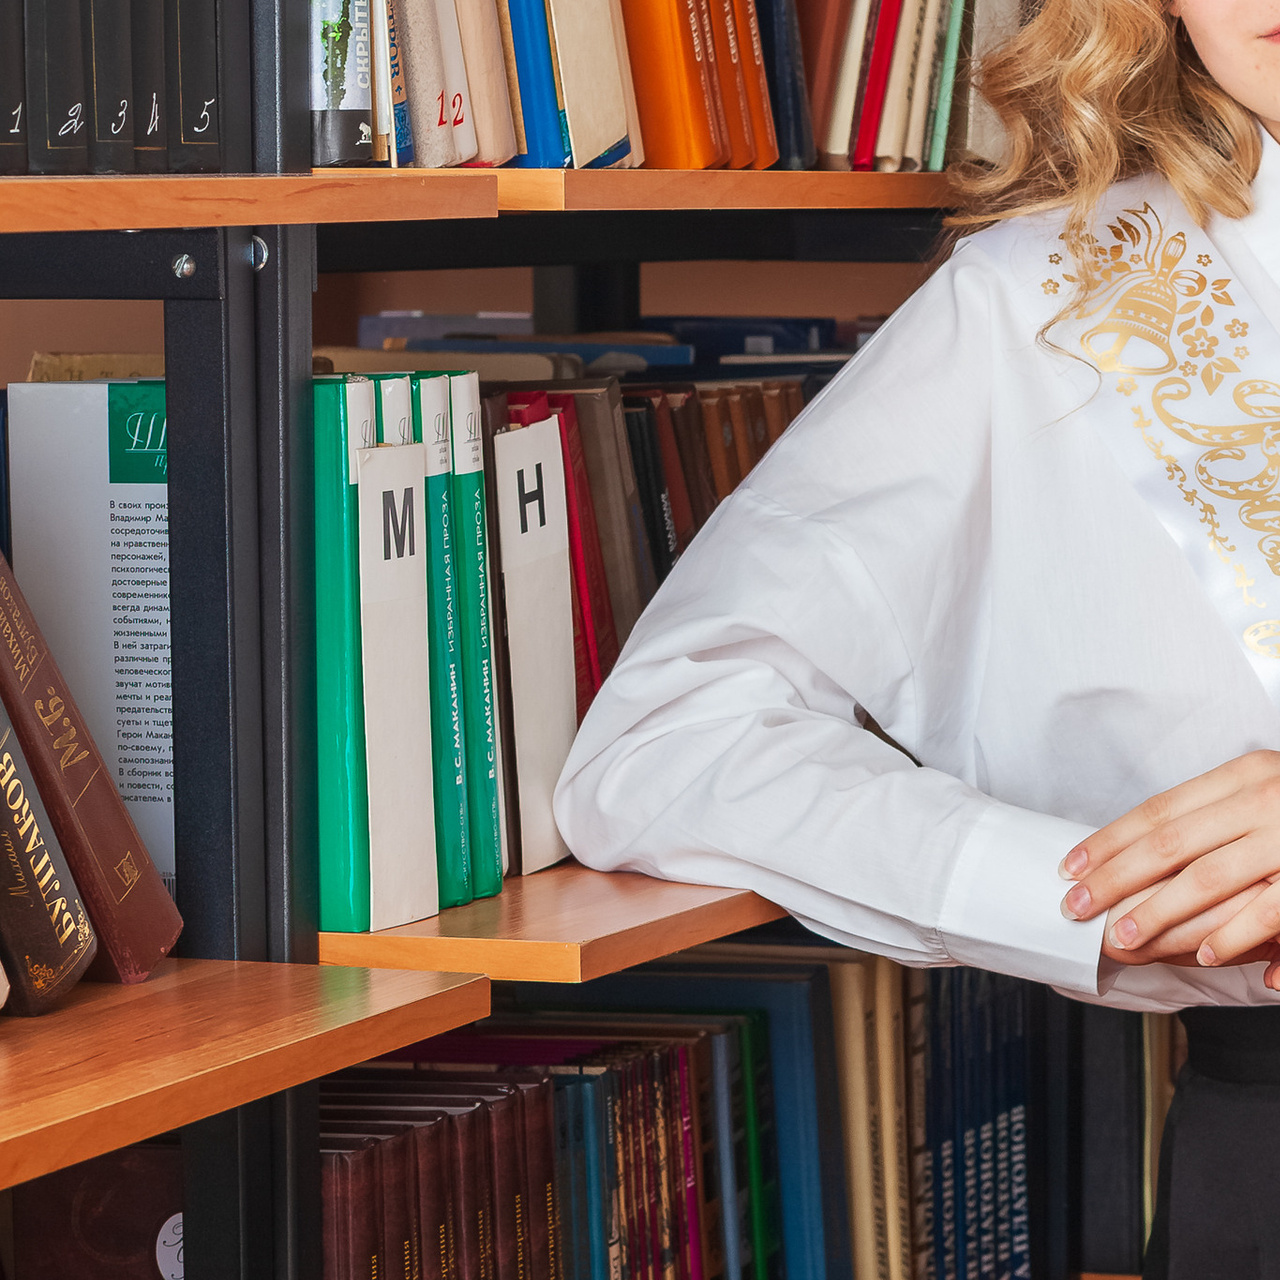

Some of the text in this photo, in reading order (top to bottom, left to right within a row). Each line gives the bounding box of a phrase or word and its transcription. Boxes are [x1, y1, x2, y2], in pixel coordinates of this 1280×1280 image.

[689, 11, 703, 63] СЕРГЕЙ
[146, 92, 160, 136] 4
[437, 89, 448, 128] 1
[451, 92, 465, 128] 2
[9, 102, 23, 134] 1
[58, 102, 85, 137] 2
[111, 99, 128, 135] 3
[193, 98, 216, 133] 5
[517, 462, 547, 534] Н
[109, 500, 142, 510] В своих
[110, 513, 152, 525] Владимир
[382, 487, 416, 561] М
[110, 552, 166, 563] персонажей,
[111, 579, 168, 588] достоверные
[112, 605, 142, 613] всегда
[112, 615, 163, 626] событиями,
[113, 630, 168, 639] жизненными
[441, 490, 463, 786] В. С. МАКАНИН ИЗБРАННАЯ ПРОЗА
[474, 488, 496, 780] В. С. МАКАНИН ИЗБРАННАЯ ПРОЗА
[113, 641, 138, 650] В ней
[114, 655, 159, 664] различные
[115, 681, 142, 690] звучат
[116, 720, 142, 729] суеты
[116, 730, 142, 740] Герои
[117, 745, 165, 754] по-своему,
[118, 767, 162, 779] В сборник
[127, 782, 163, 791] повести,
